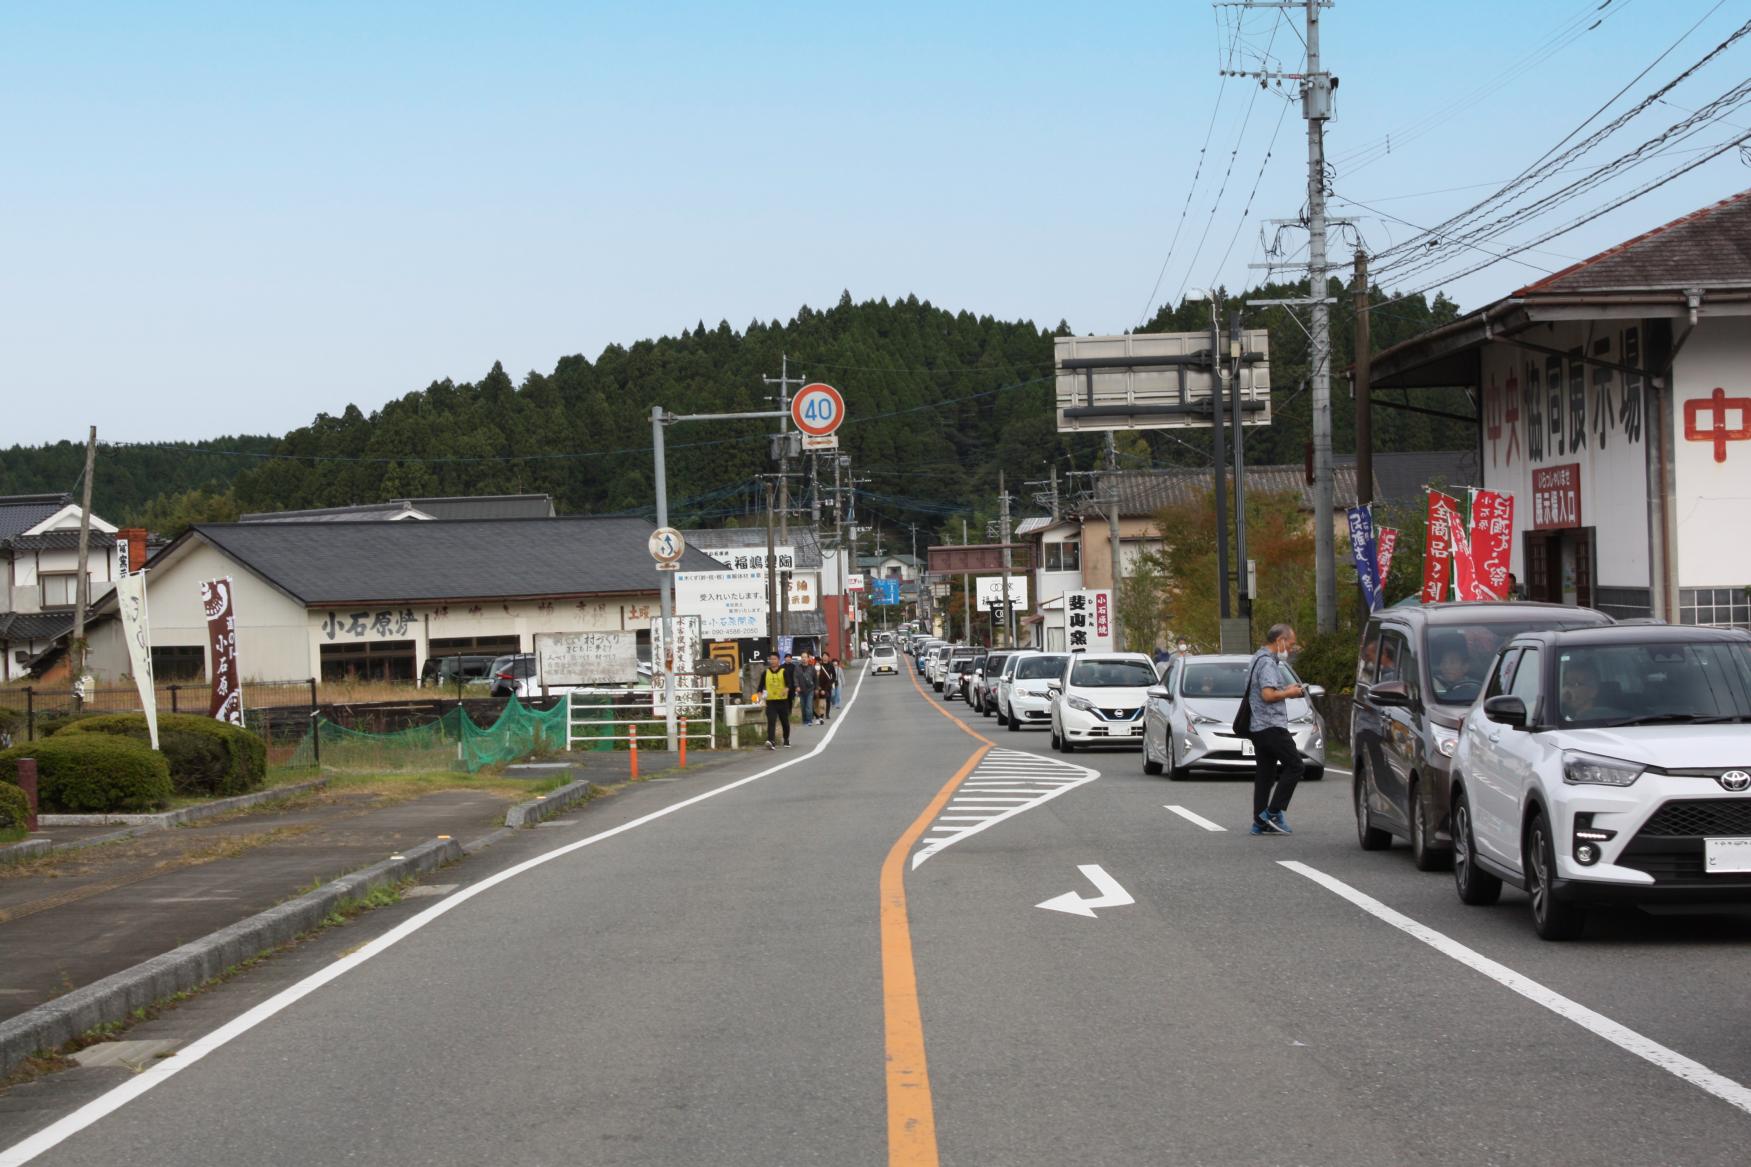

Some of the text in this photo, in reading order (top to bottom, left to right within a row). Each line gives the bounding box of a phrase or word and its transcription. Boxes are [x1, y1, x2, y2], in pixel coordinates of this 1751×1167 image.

[804, 398, 832, 421] 40
[1684, 387, 1751, 463] 中
[1538, 471, 1570, 488] いらっしゃいませ
[1535, 490, 1575, 524] 展示場入口
[321, 608, 418, 641] 小石原焼
[216, 634, 228, 696] 小石原
[754, 650, 760, 659] P
